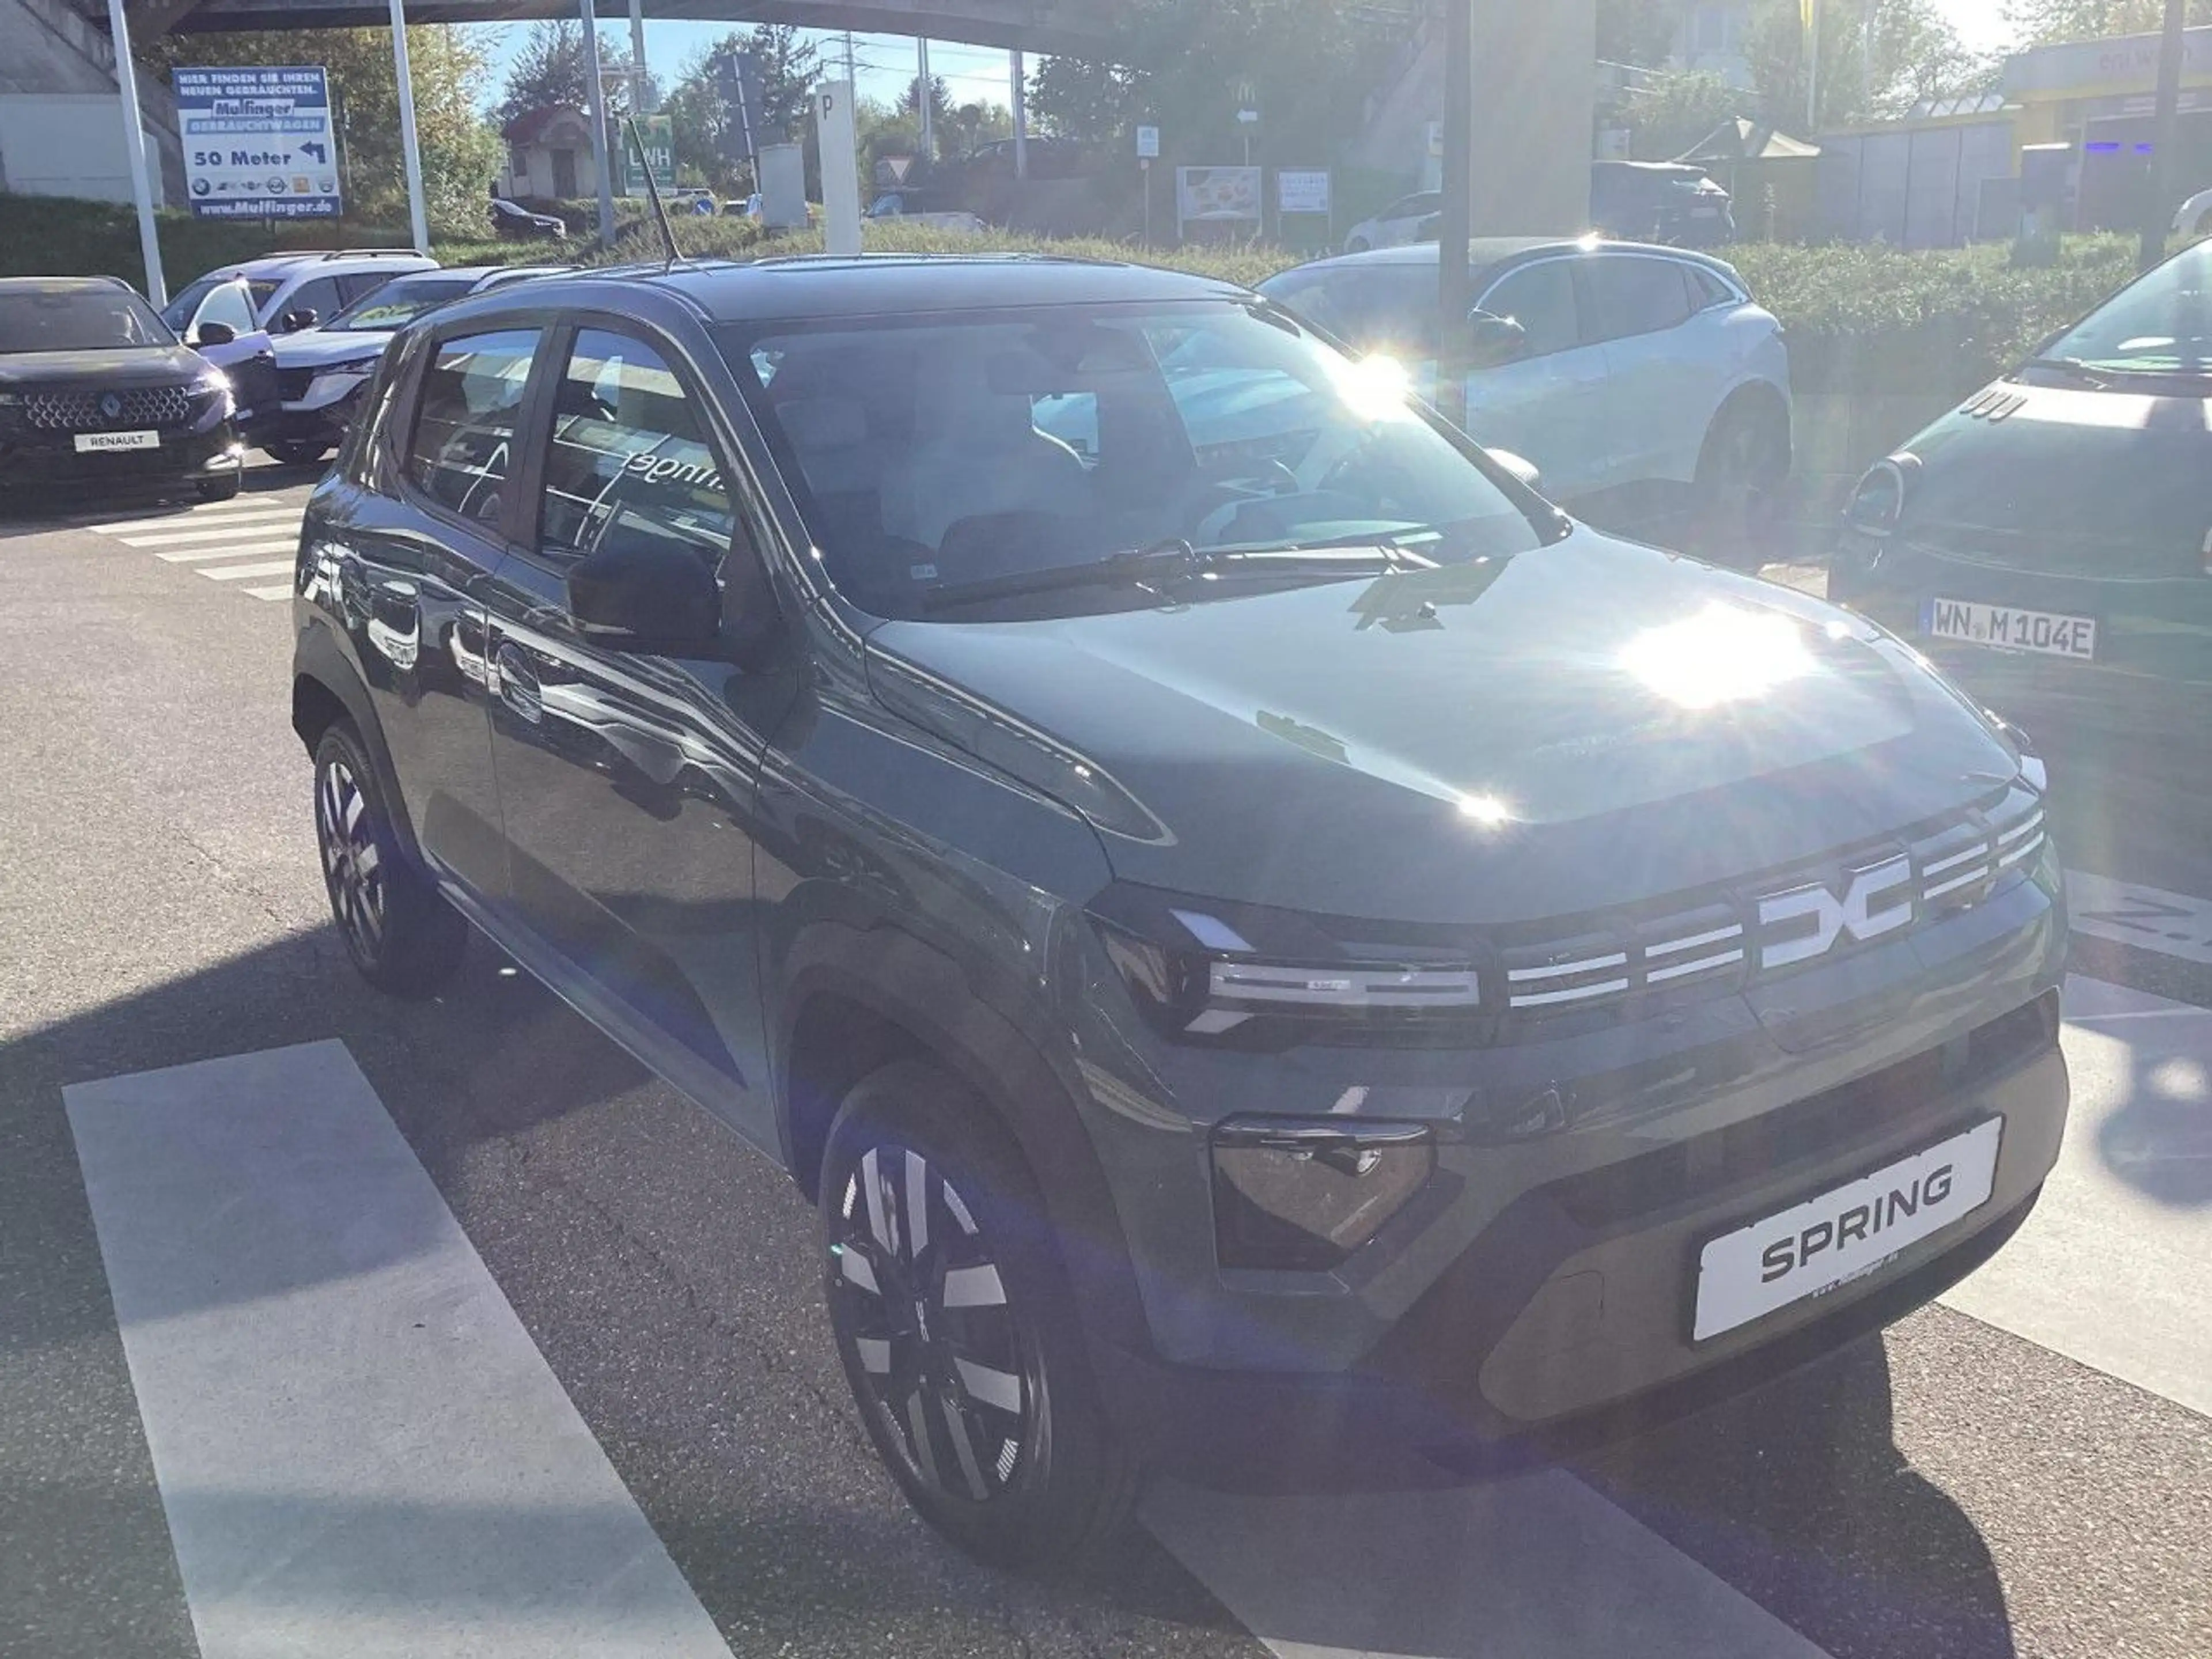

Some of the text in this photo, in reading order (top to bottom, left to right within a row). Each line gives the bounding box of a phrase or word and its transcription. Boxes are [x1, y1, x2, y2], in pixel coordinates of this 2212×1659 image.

[179, 72, 320, 84] HIER FINDEN SIE IHREN
[180, 85, 222, 96] NEUEN
[215, 98, 291, 118] Mulfinger
[823, 95, 833, 121] P
[191, 119, 320, 132] GEBRAUCHTWAGEN
[194, 150, 292, 166] 50 Meter
[200, 199, 332, 215] www.Mulfinger.de
[90, 435, 144, 447] RENAULT
[1936, 602, 1971, 636] WN
[1761, 1164, 1953, 1283] SPRING
